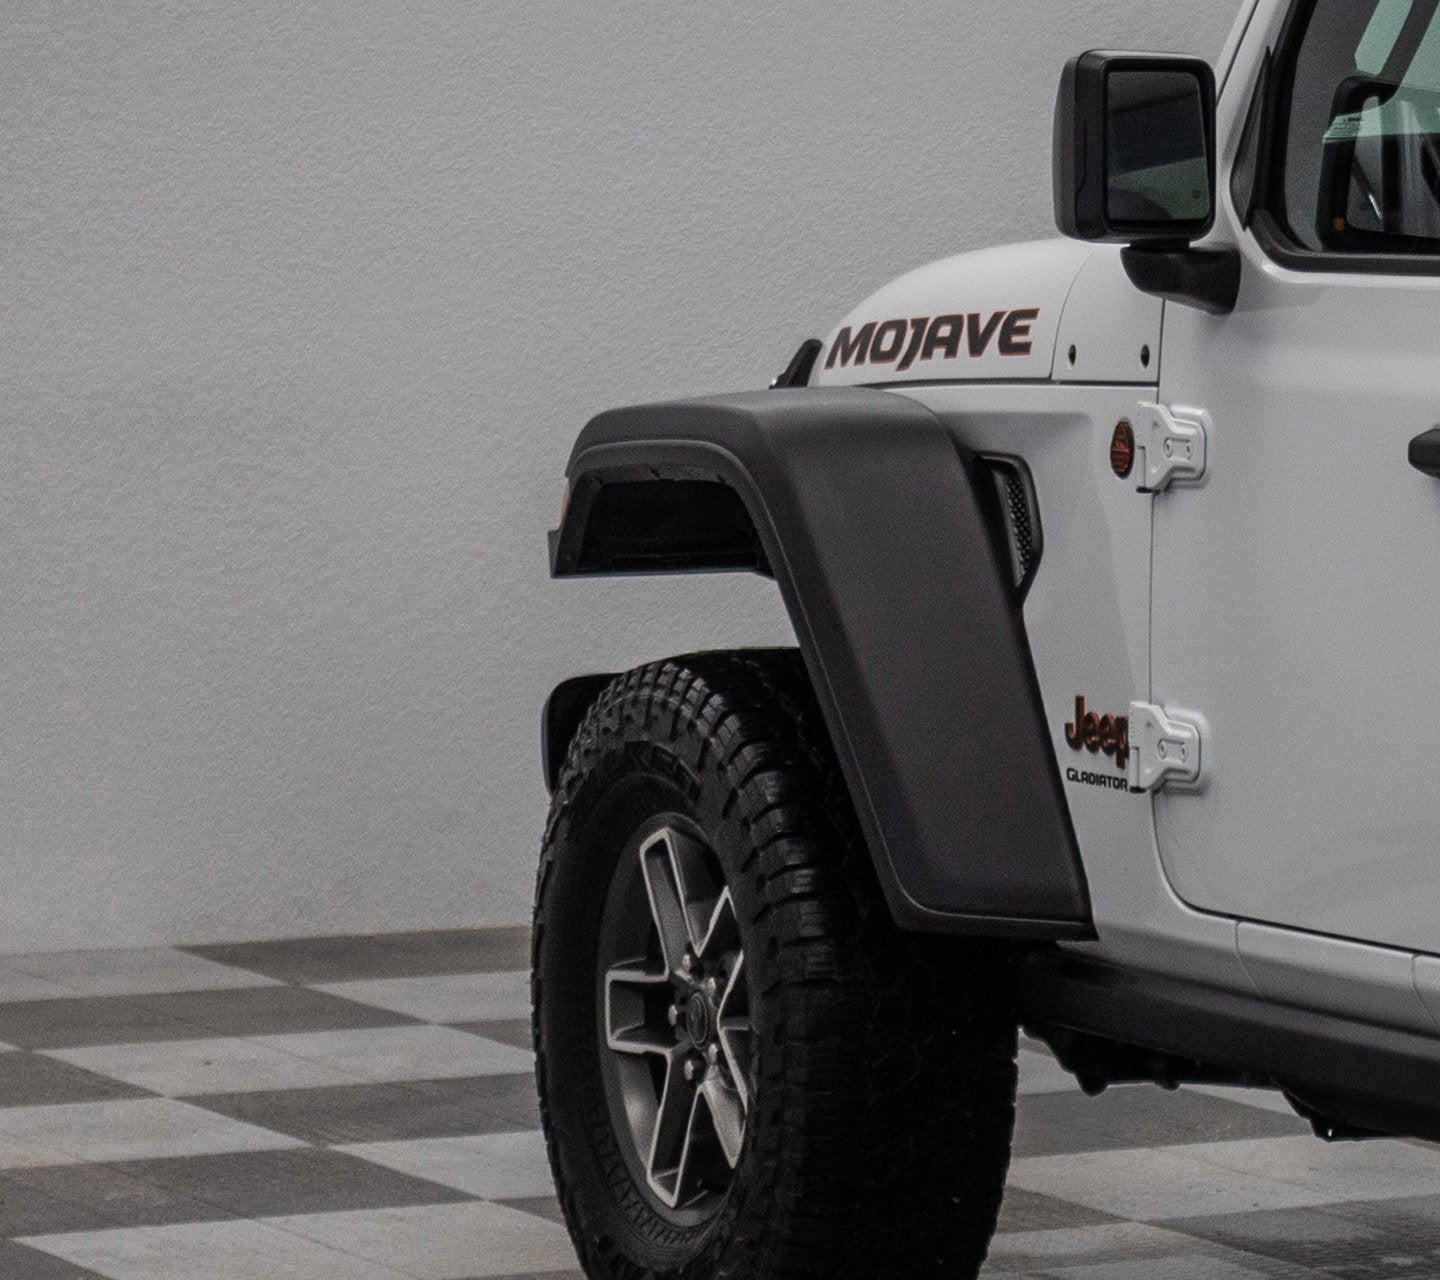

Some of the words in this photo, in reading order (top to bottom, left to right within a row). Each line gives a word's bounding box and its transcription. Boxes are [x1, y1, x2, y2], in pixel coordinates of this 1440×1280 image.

[824, 307, 1040, 371] MOJAVE
[1064, 695, 1130, 769] Jeep
[1066, 767, 1128, 792] GLADIATOR
